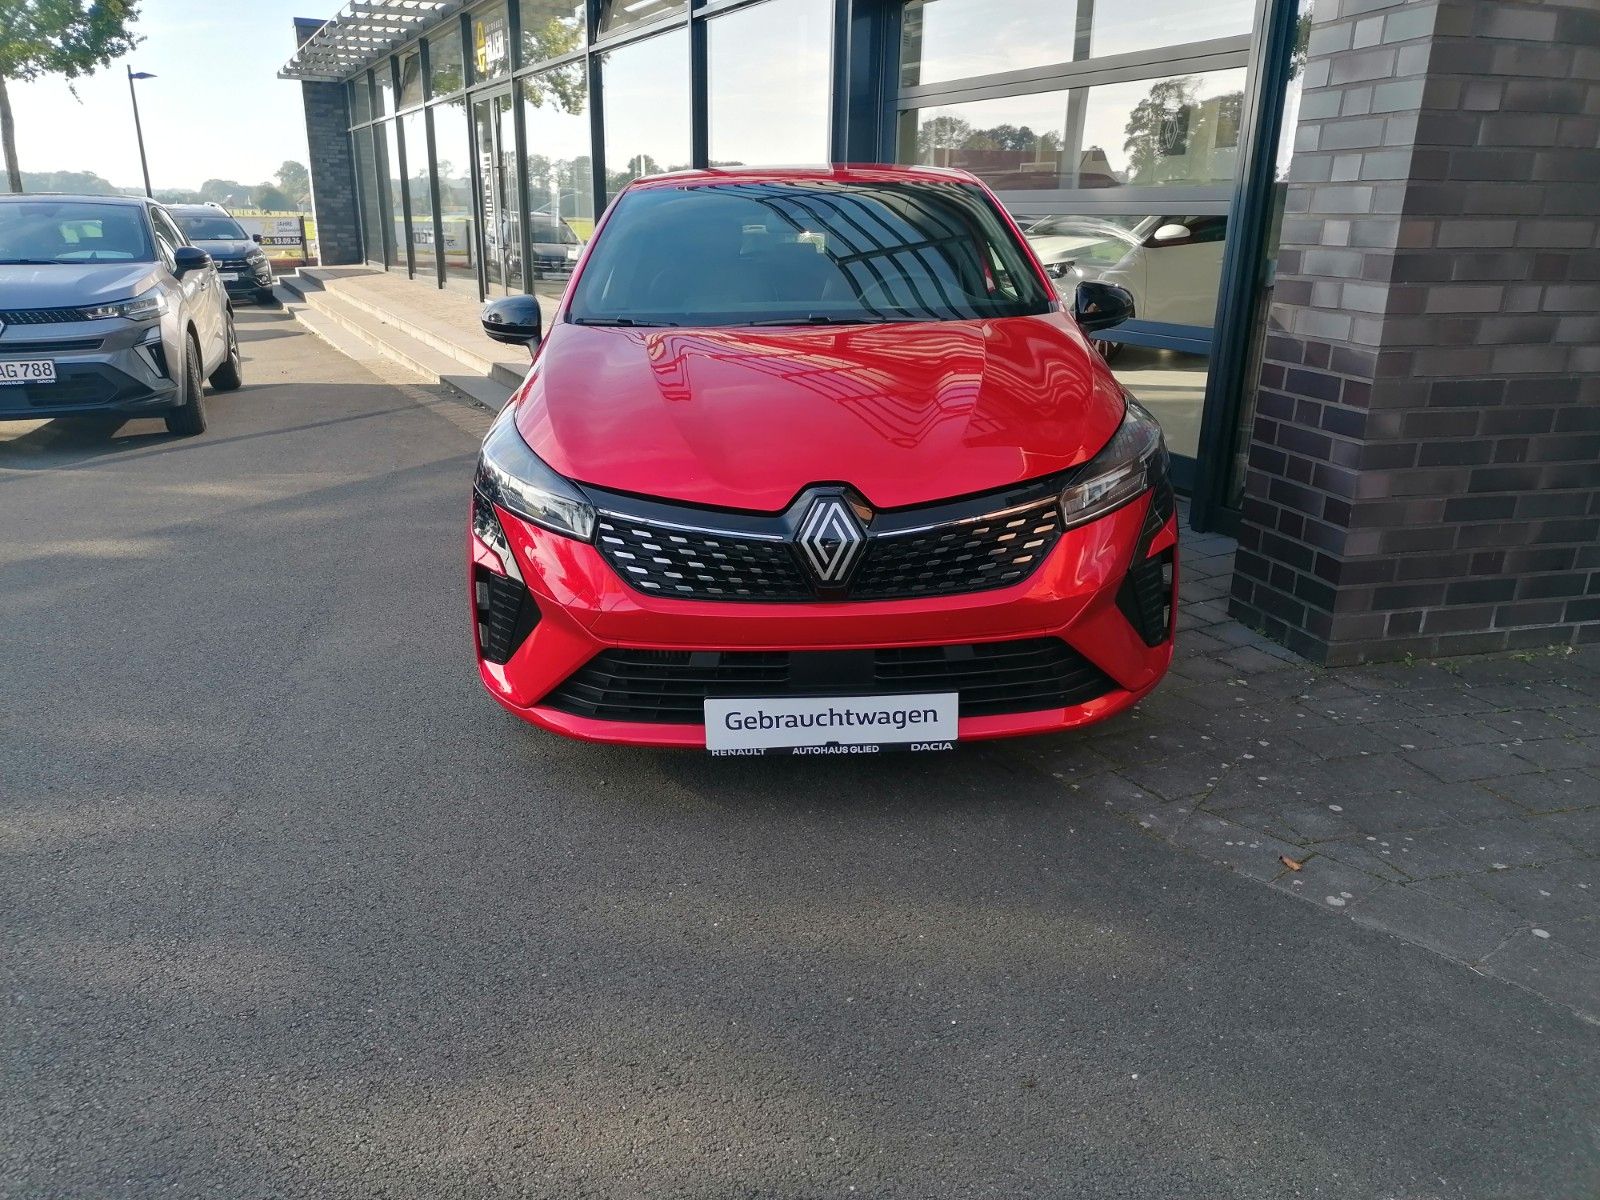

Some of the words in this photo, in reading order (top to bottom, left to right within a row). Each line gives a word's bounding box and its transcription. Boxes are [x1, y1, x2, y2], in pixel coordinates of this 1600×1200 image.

[20, 362, 53, 378] 788
[725, 707, 938, 730] Gebrauchtwagen
[711, 748, 767, 757] RENAULT
[792, 746, 848, 755] AUTOHAUS
[850, 745, 880, 754] GLIED
[910, 742, 954, 752] DACIA
